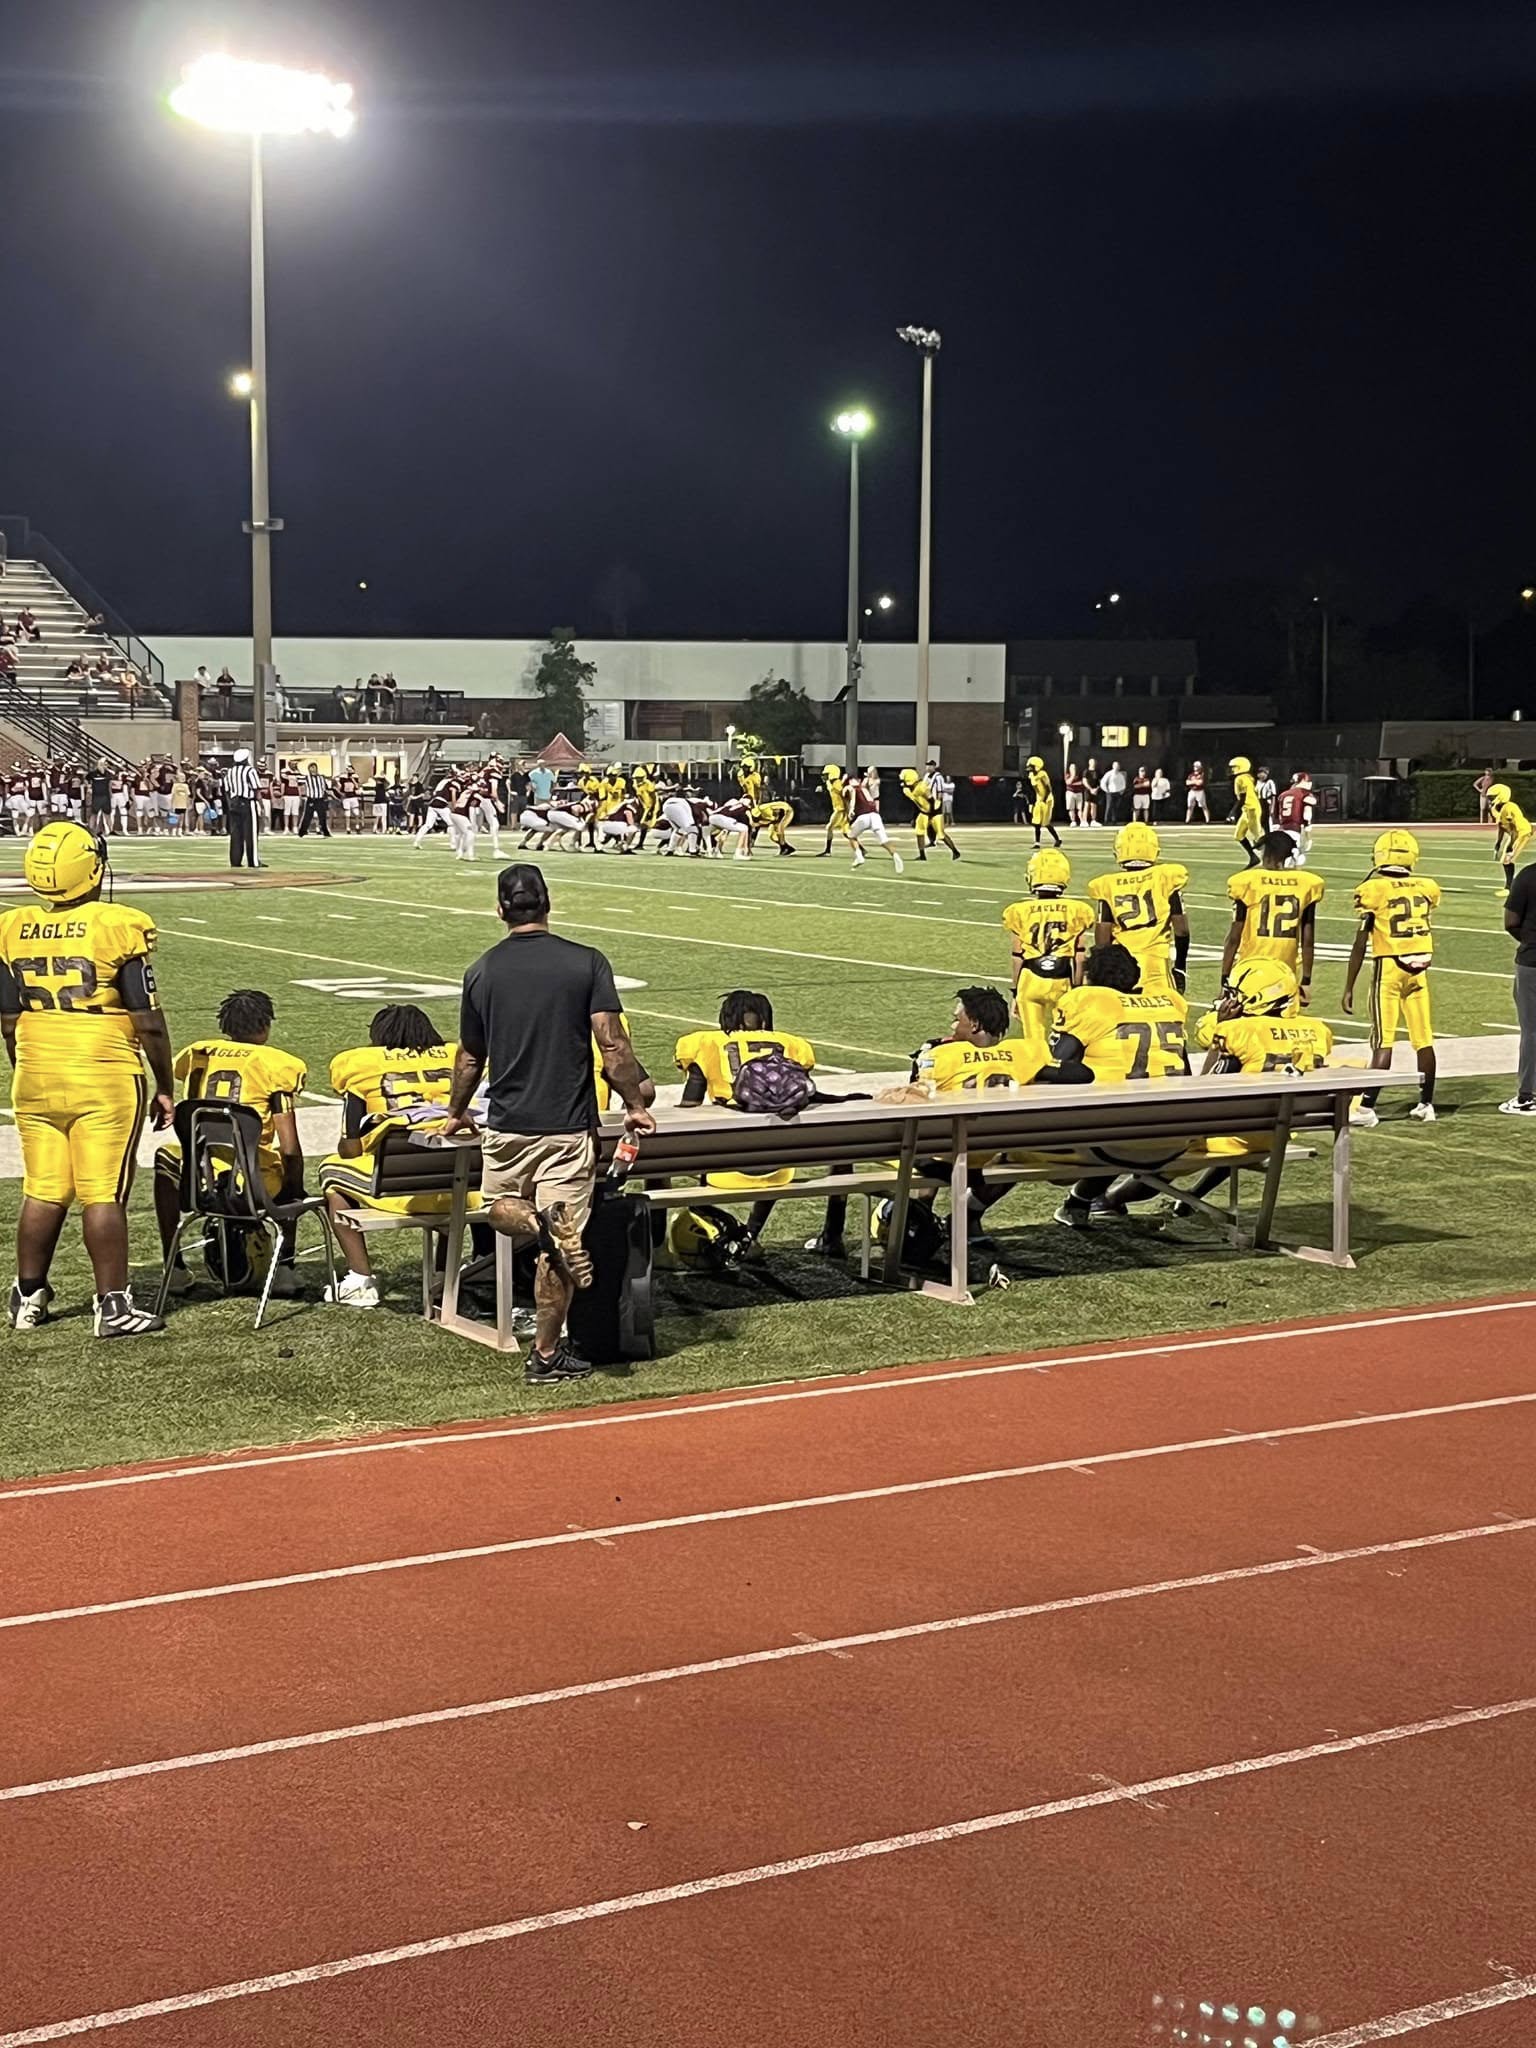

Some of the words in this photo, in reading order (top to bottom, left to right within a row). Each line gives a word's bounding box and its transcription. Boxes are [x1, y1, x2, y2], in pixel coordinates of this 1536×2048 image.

[19, 921, 87, 940] EAGLES
[1114, 889, 1157, 931] 21
[1257, 894, 1300, 938] 12
[11, 956, 101, 1013] 62
[1117, 994, 1174, 1008] EAGLES
[962, 1050, 1014, 1064] EAGLES
[1115, 1021, 1184, 1079] 75
